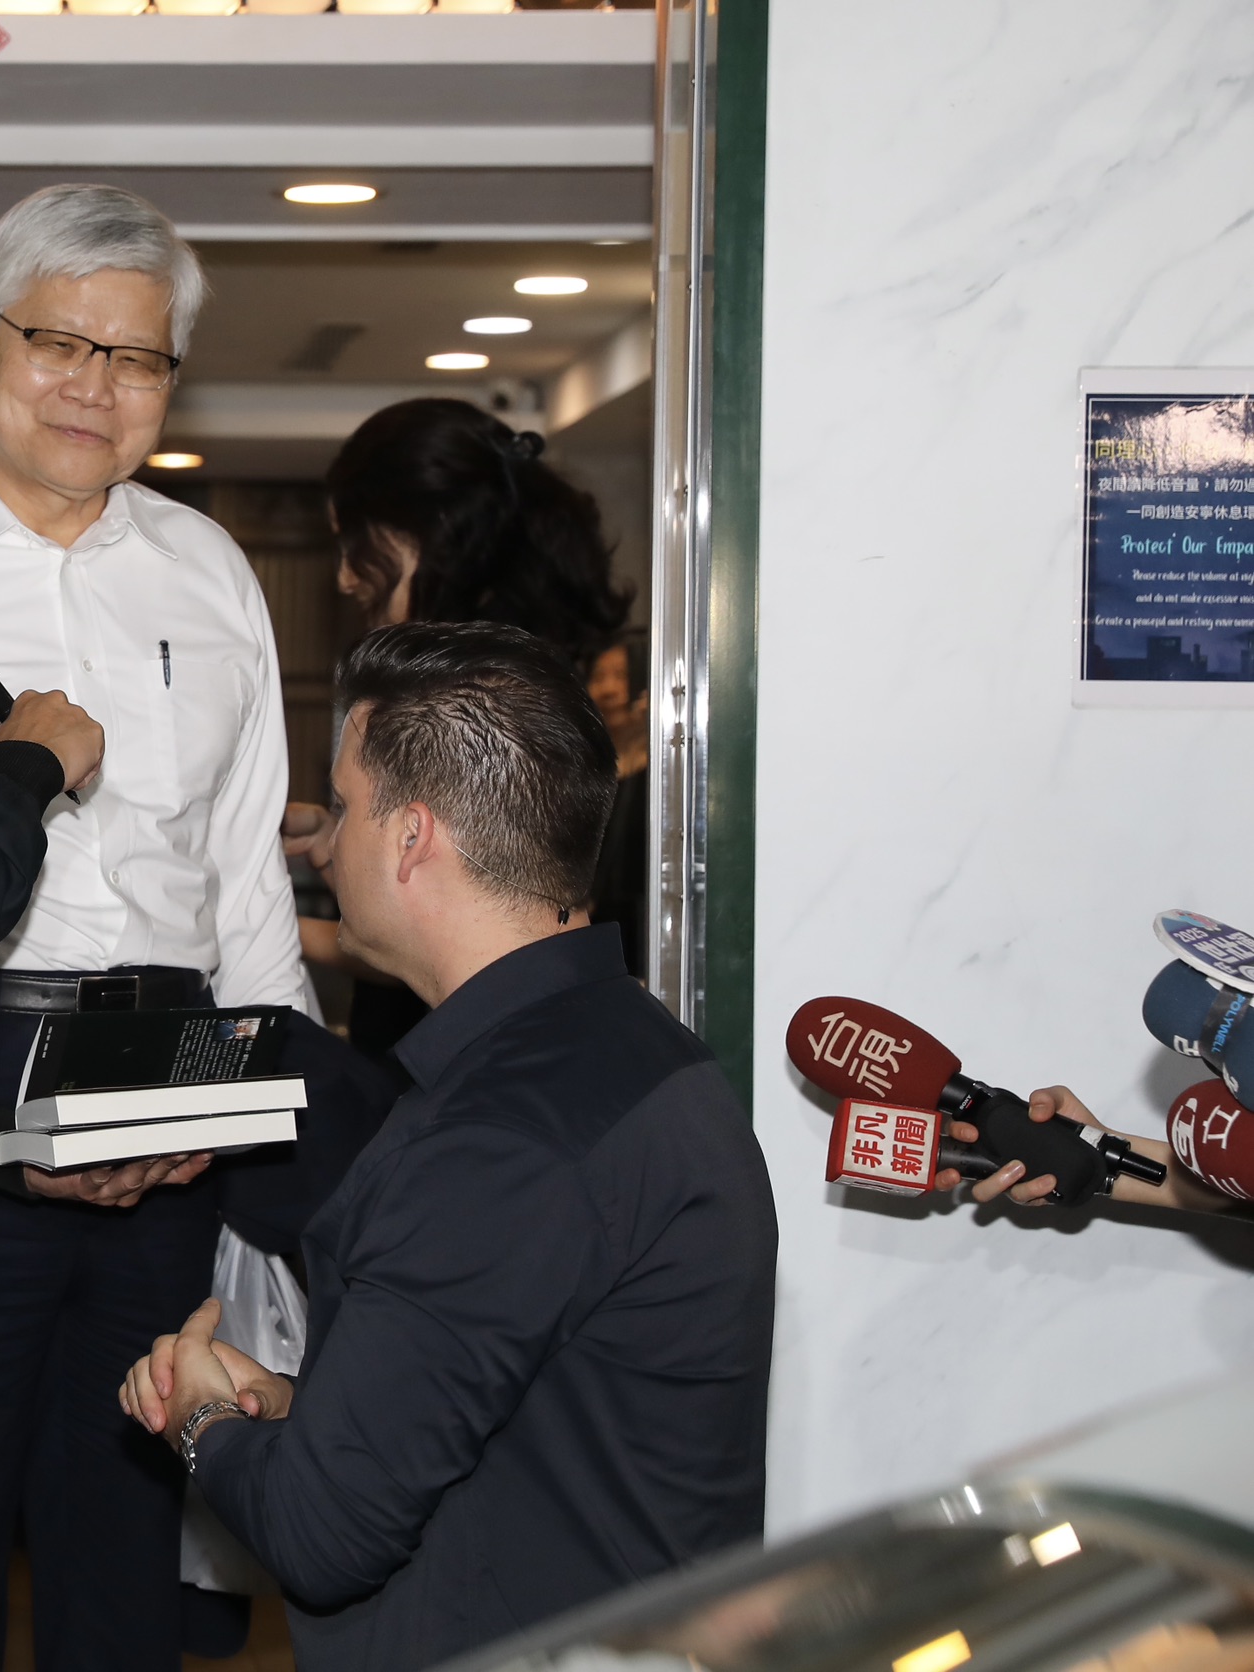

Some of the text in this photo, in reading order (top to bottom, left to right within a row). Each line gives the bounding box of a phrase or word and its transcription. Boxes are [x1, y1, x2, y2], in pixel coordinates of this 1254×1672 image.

[1120, 534, 1173, 555] Protect
[1182, 535, 1207, 555] Our
[1132, 569, 1156, 582] Please
[1158, 570, 1185, 582] reduce
[1187, 571, 1200, 582] the
[1201, 570, 1227, 582] volume
[1229, 572, 1239, 582] at
[1135, 593, 1152, 603] and
[1153, 593, 1164, 603] do
[1165, 594, 1178, 604] not
[1180, 592, 1200, 604] make
[1094, 614, 1123, 626] Create
[1124, 618, 1131, 626] a
[1167, 616, 1183, 627] and
[1184, 616, 1213, 631] resting
[1173, 927, 1209, 943] 2025
[1211, 993, 1246, 1053] POLYWELL
[808, 1011, 912, 1097] 台視
[959, 1094, 972, 1110] SONY
[851, 1112, 888, 1168] 非凡
[890, 1115, 928, 1176] 新聞
